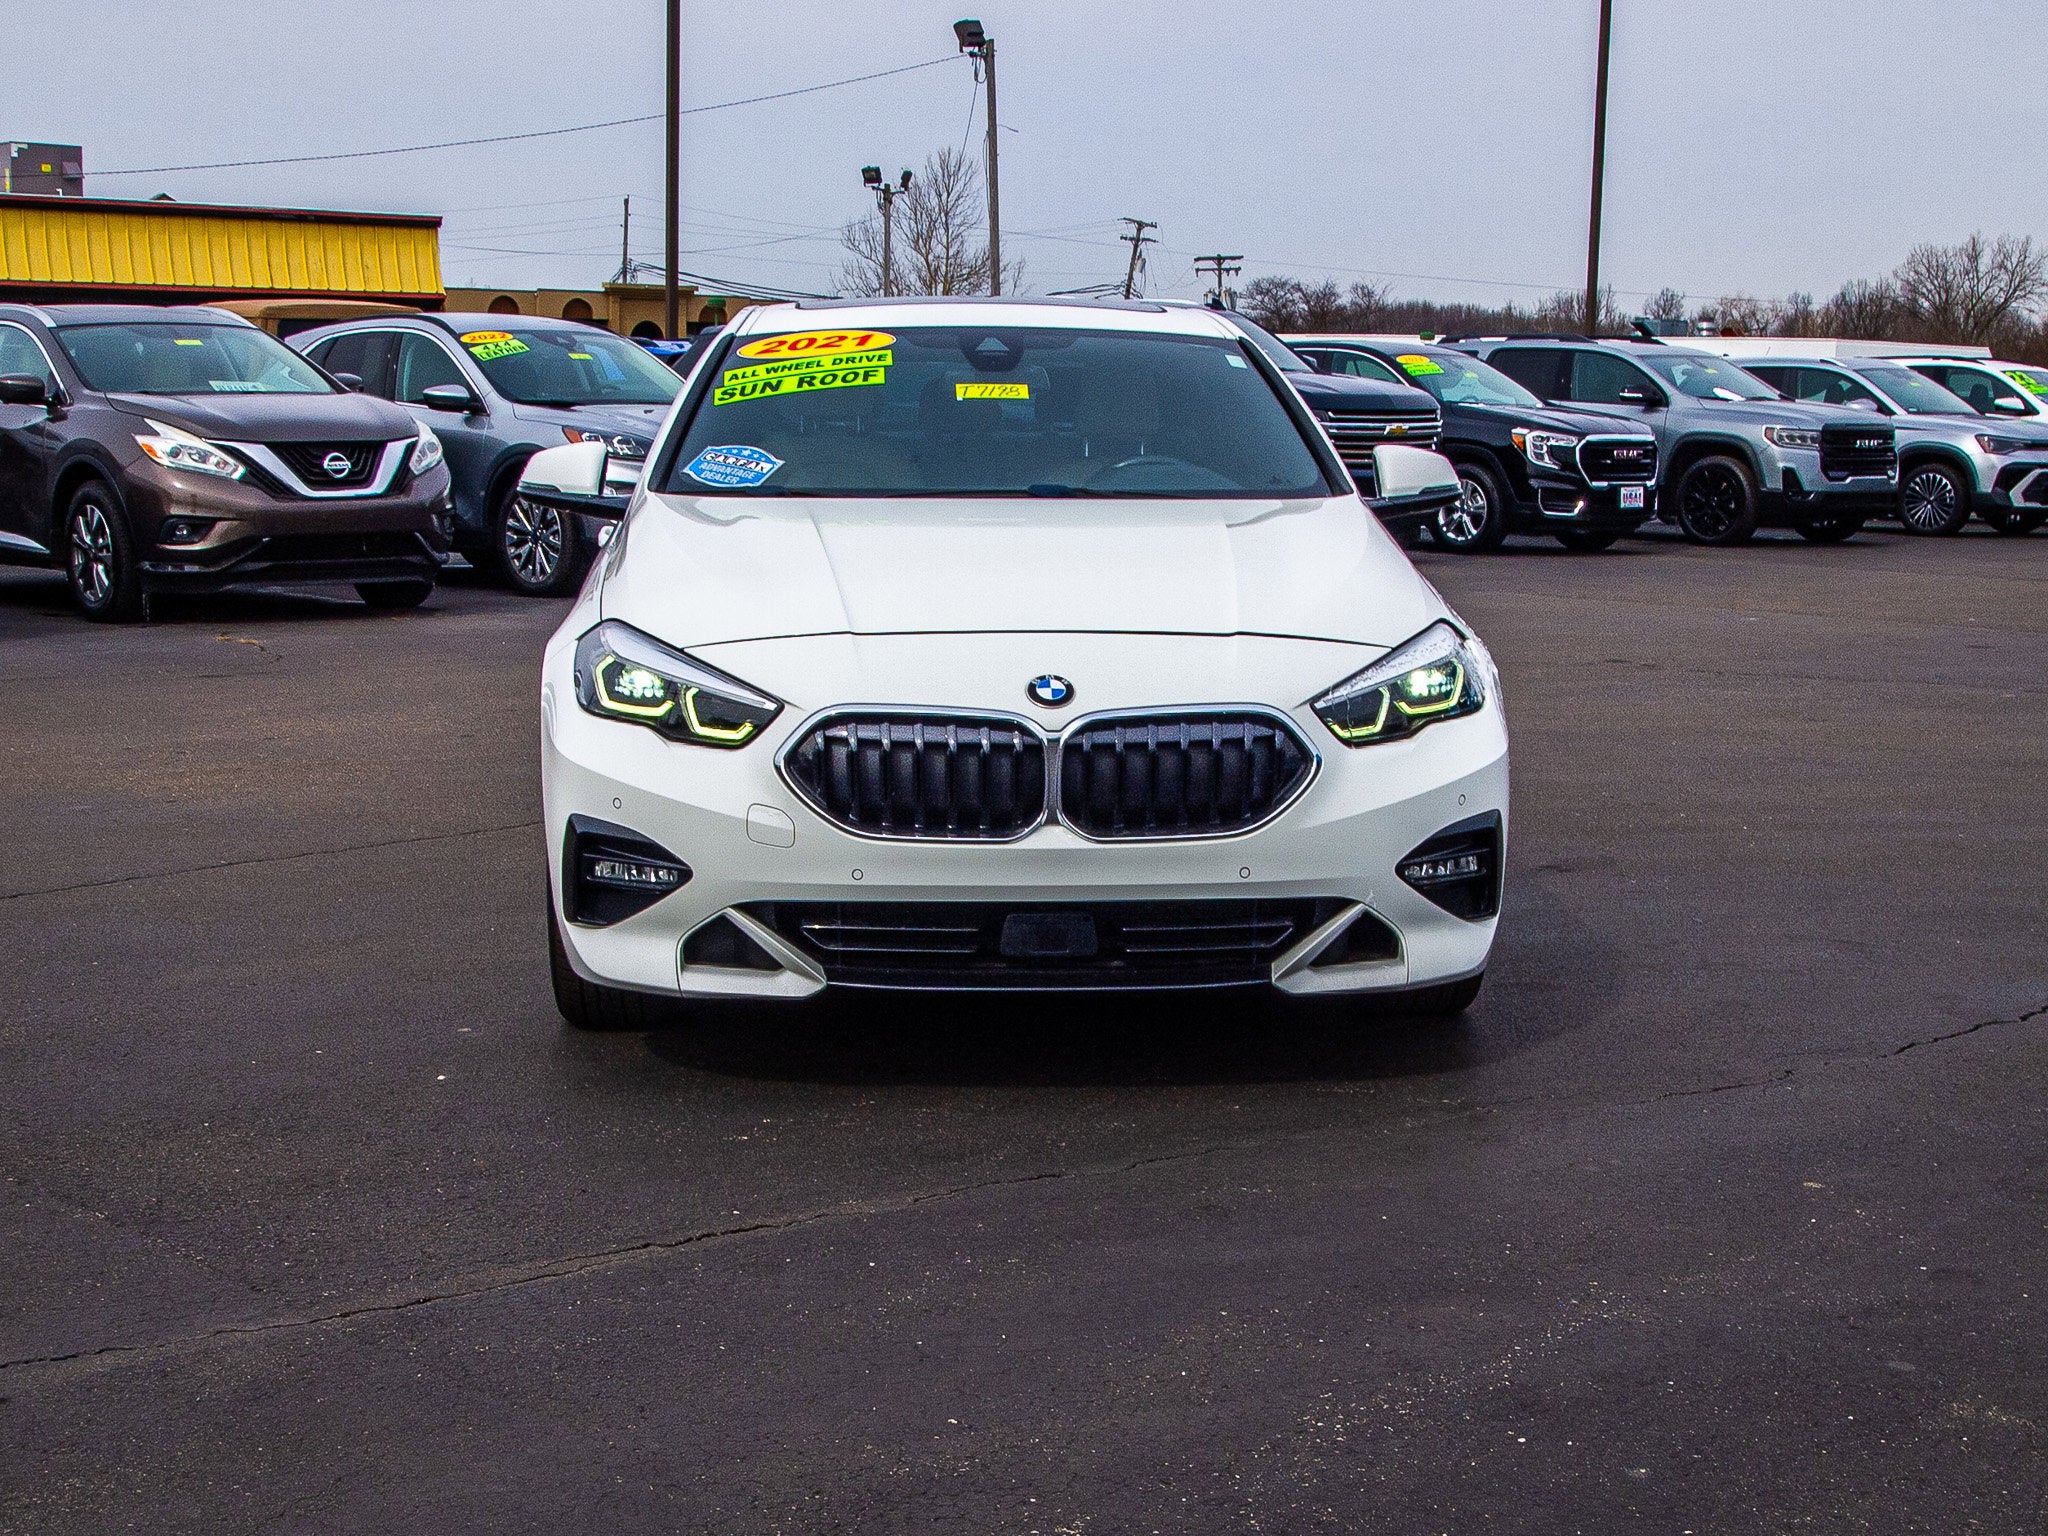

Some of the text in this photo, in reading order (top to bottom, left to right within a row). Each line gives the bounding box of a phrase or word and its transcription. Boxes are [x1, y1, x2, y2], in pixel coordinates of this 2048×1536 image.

[478, 345, 526, 359] LEATHER
[754, 334, 876, 355] 2021
[728, 353, 888, 382] ALL WHEEL DRIVE
[717, 369, 880, 402] SUN ROOF
[698, 461, 757, 479] ADVANTAGE
[704, 451, 774, 474] CARFAX
[700, 470, 740, 485] DEALER
